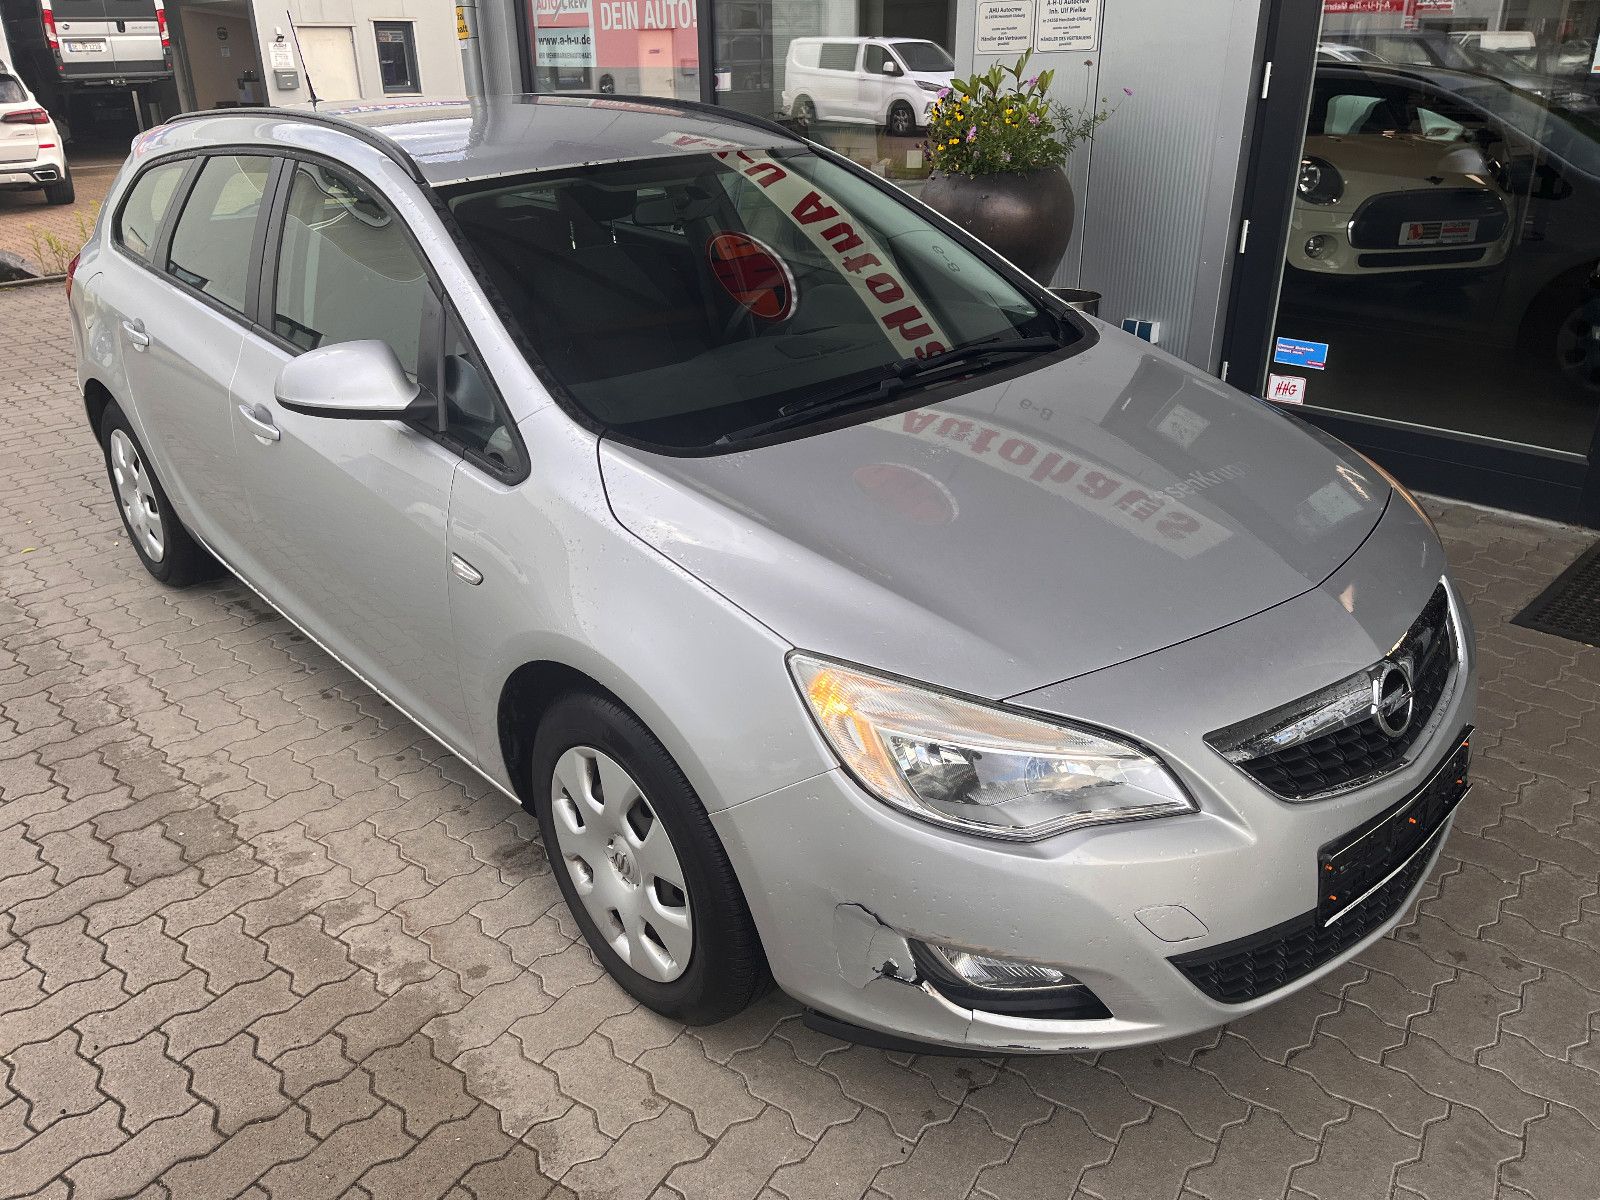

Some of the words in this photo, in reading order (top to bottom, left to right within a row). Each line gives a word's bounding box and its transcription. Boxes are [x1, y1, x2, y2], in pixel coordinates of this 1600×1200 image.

[600, 2, 639, 30] DEIN
[538, 34, 591, 45] www.a-h-u.de
[1275, 381, 1297, 396] HHG
